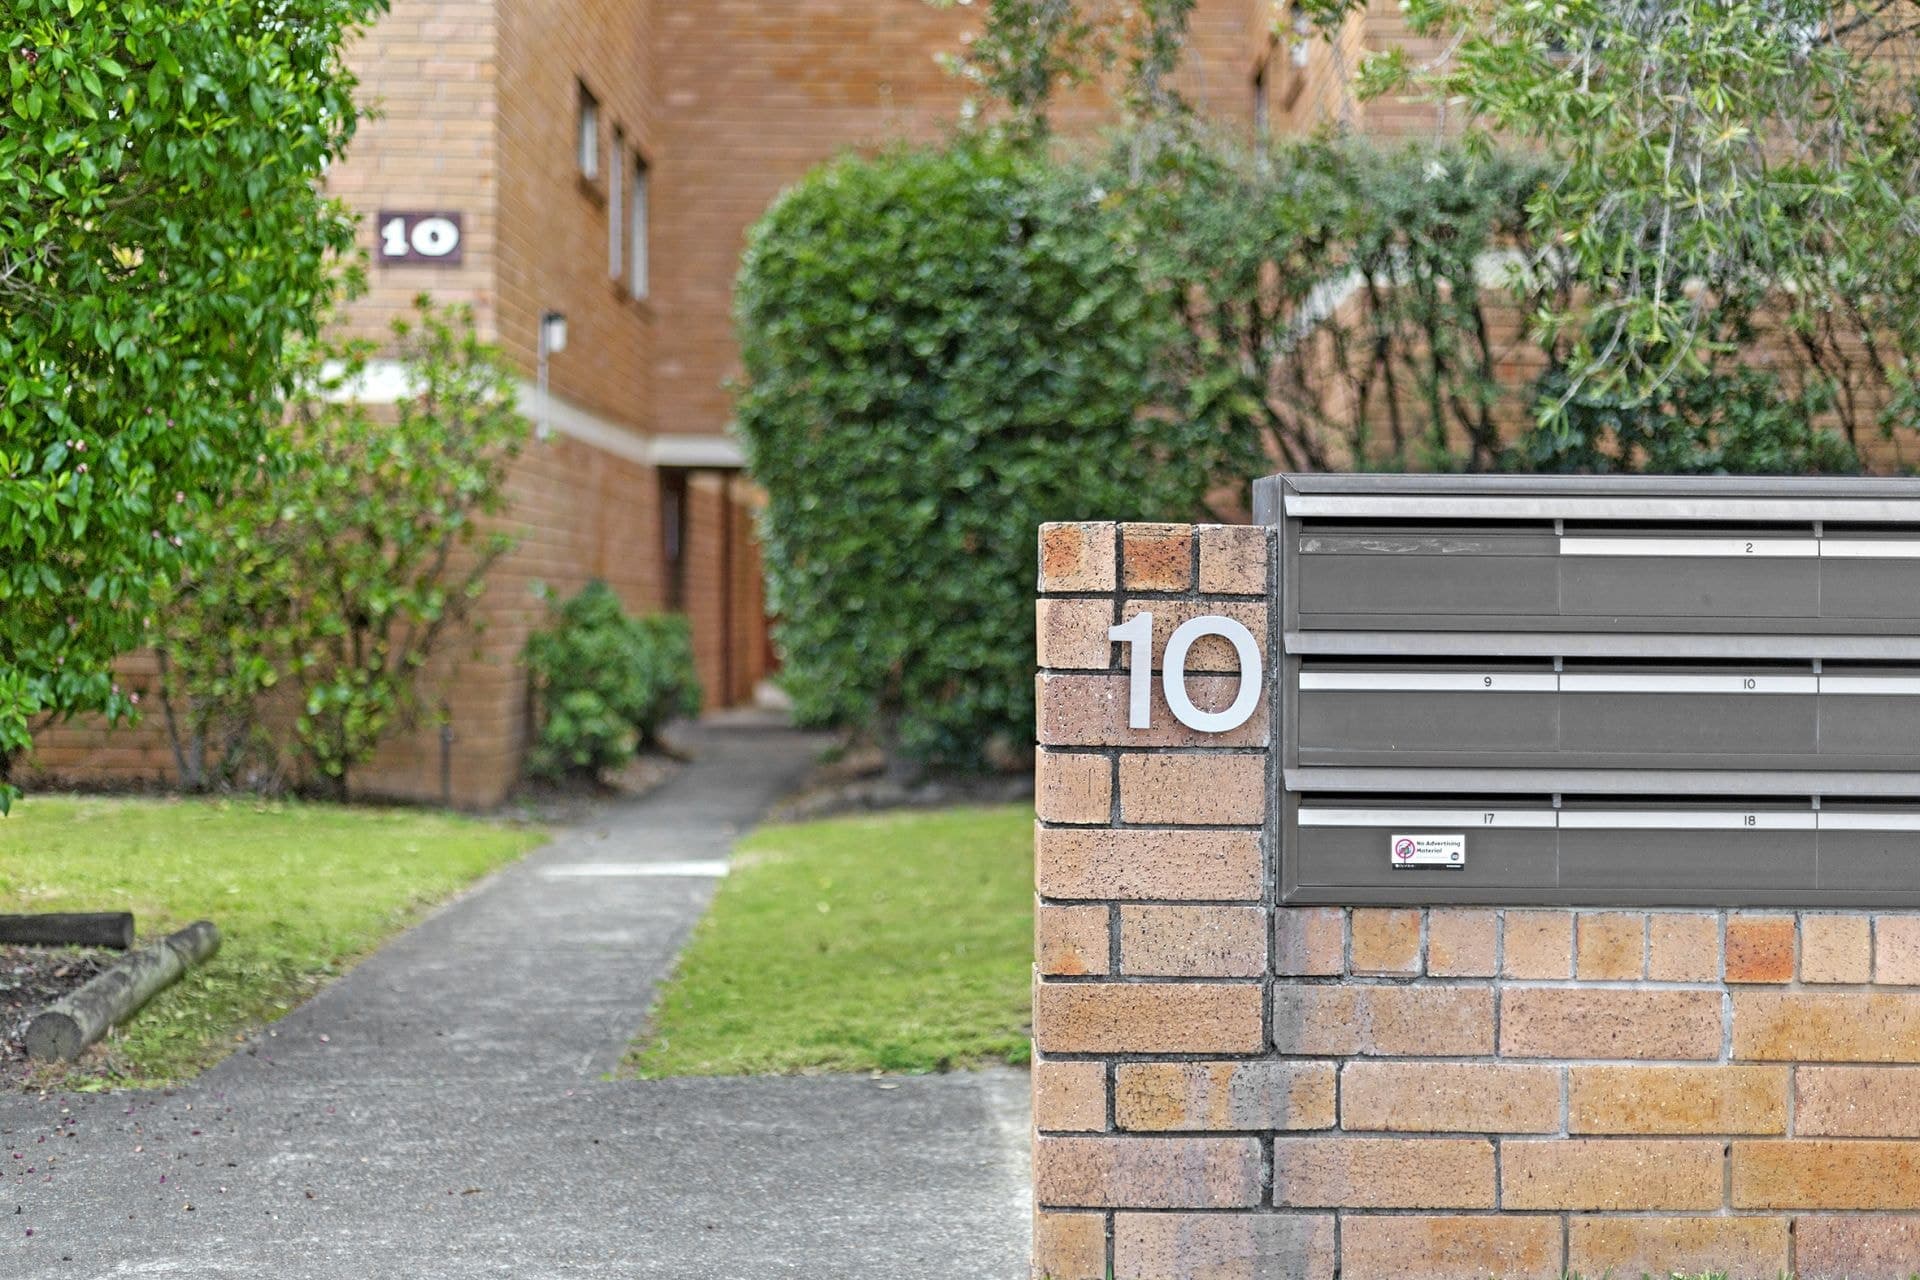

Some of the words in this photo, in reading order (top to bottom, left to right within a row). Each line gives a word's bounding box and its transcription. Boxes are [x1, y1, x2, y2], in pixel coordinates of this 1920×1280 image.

[381, 217, 459, 256] 10
[1745, 542, 1753, 553] 2
[1108, 611, 1263, 733] 10
[1483, 676, 1492, 687] 9
[1743, 678, 1756, 690] 10
[1483, 813, 1495, 824] 17
[1743, 815, 1756, 826] 18
